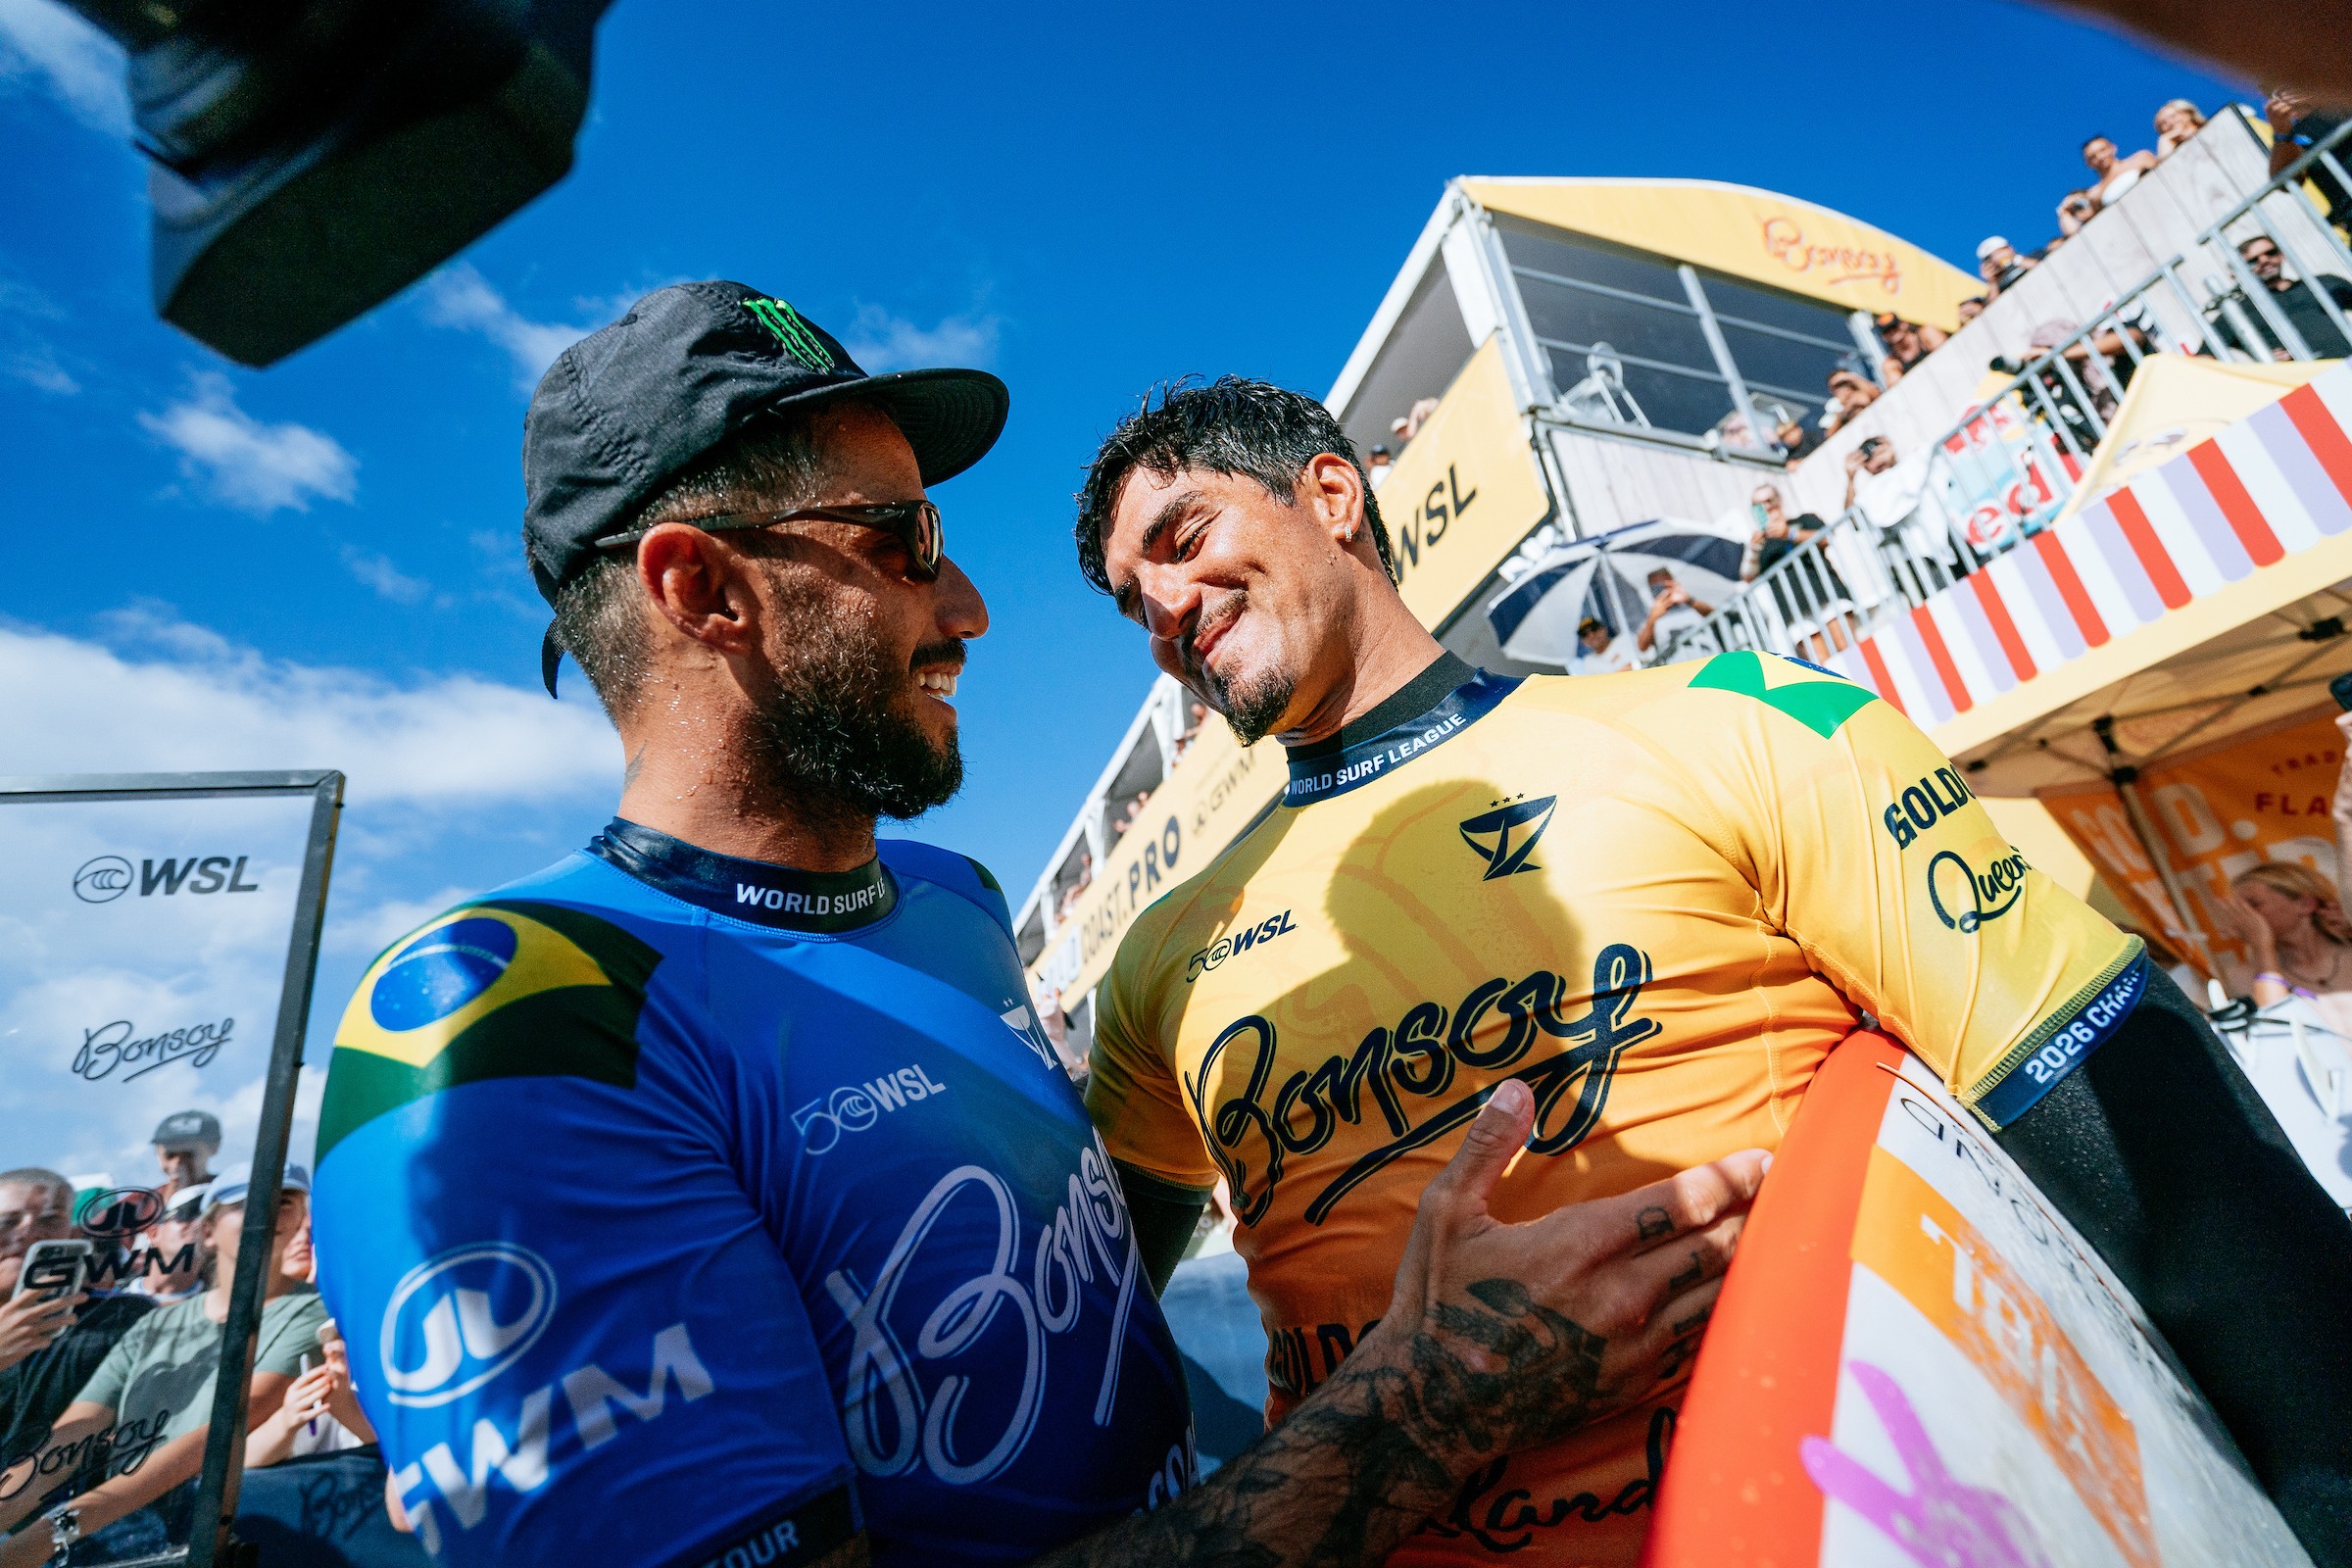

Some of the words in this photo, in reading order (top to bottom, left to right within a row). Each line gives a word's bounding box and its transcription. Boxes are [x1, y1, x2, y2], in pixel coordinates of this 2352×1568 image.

[1393, 462, 1477, 585] WSL
[1291, 772, 1333, 796] WORLD
[1336, 754, 1385, 786] SURF
[1388, 712, 1468, 764] LEAGUE
[140, 856, 259, 896] WSL
[1129, 815, 1180, 910] PRO
[736, 883, 830, 915] WORLD
[833, 884, 876, 914] SURF
[1233, 909, 1297, 956] WSL
[72, 1017, 234, 1083] Bonsoy
[2025, 1021, 2095, 1084] 2026
[868, 1063, 947, 1114] WSL
[1184, 943, 1663, 1229] Bonsoy
[24, 1243, 195, 1290] GWM
